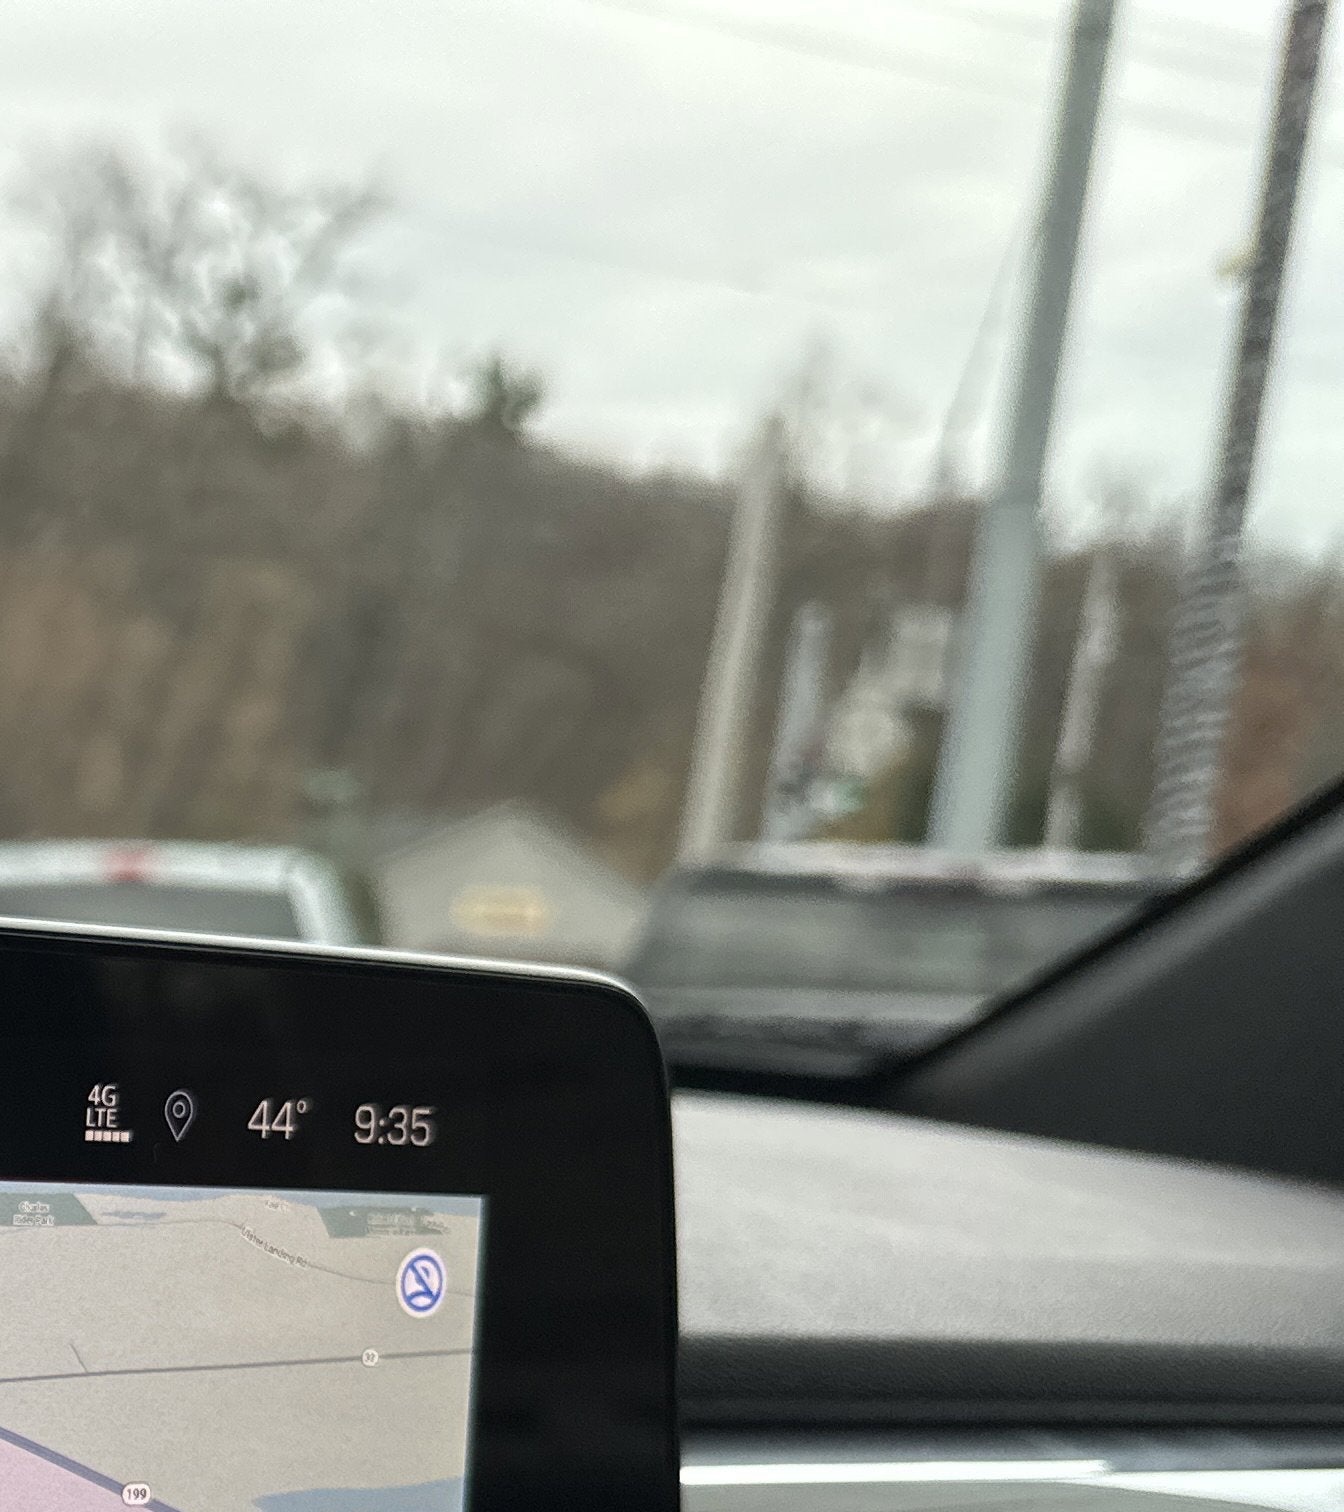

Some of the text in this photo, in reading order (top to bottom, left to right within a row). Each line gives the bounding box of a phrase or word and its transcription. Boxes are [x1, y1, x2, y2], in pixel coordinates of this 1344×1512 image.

[87, 1084, 118, 1108] 4G
[85, 1108, 118, 1129] LTE
[353, 1103, 436, 1147] 9:35
[126, 1487, 147, 1501] 199
